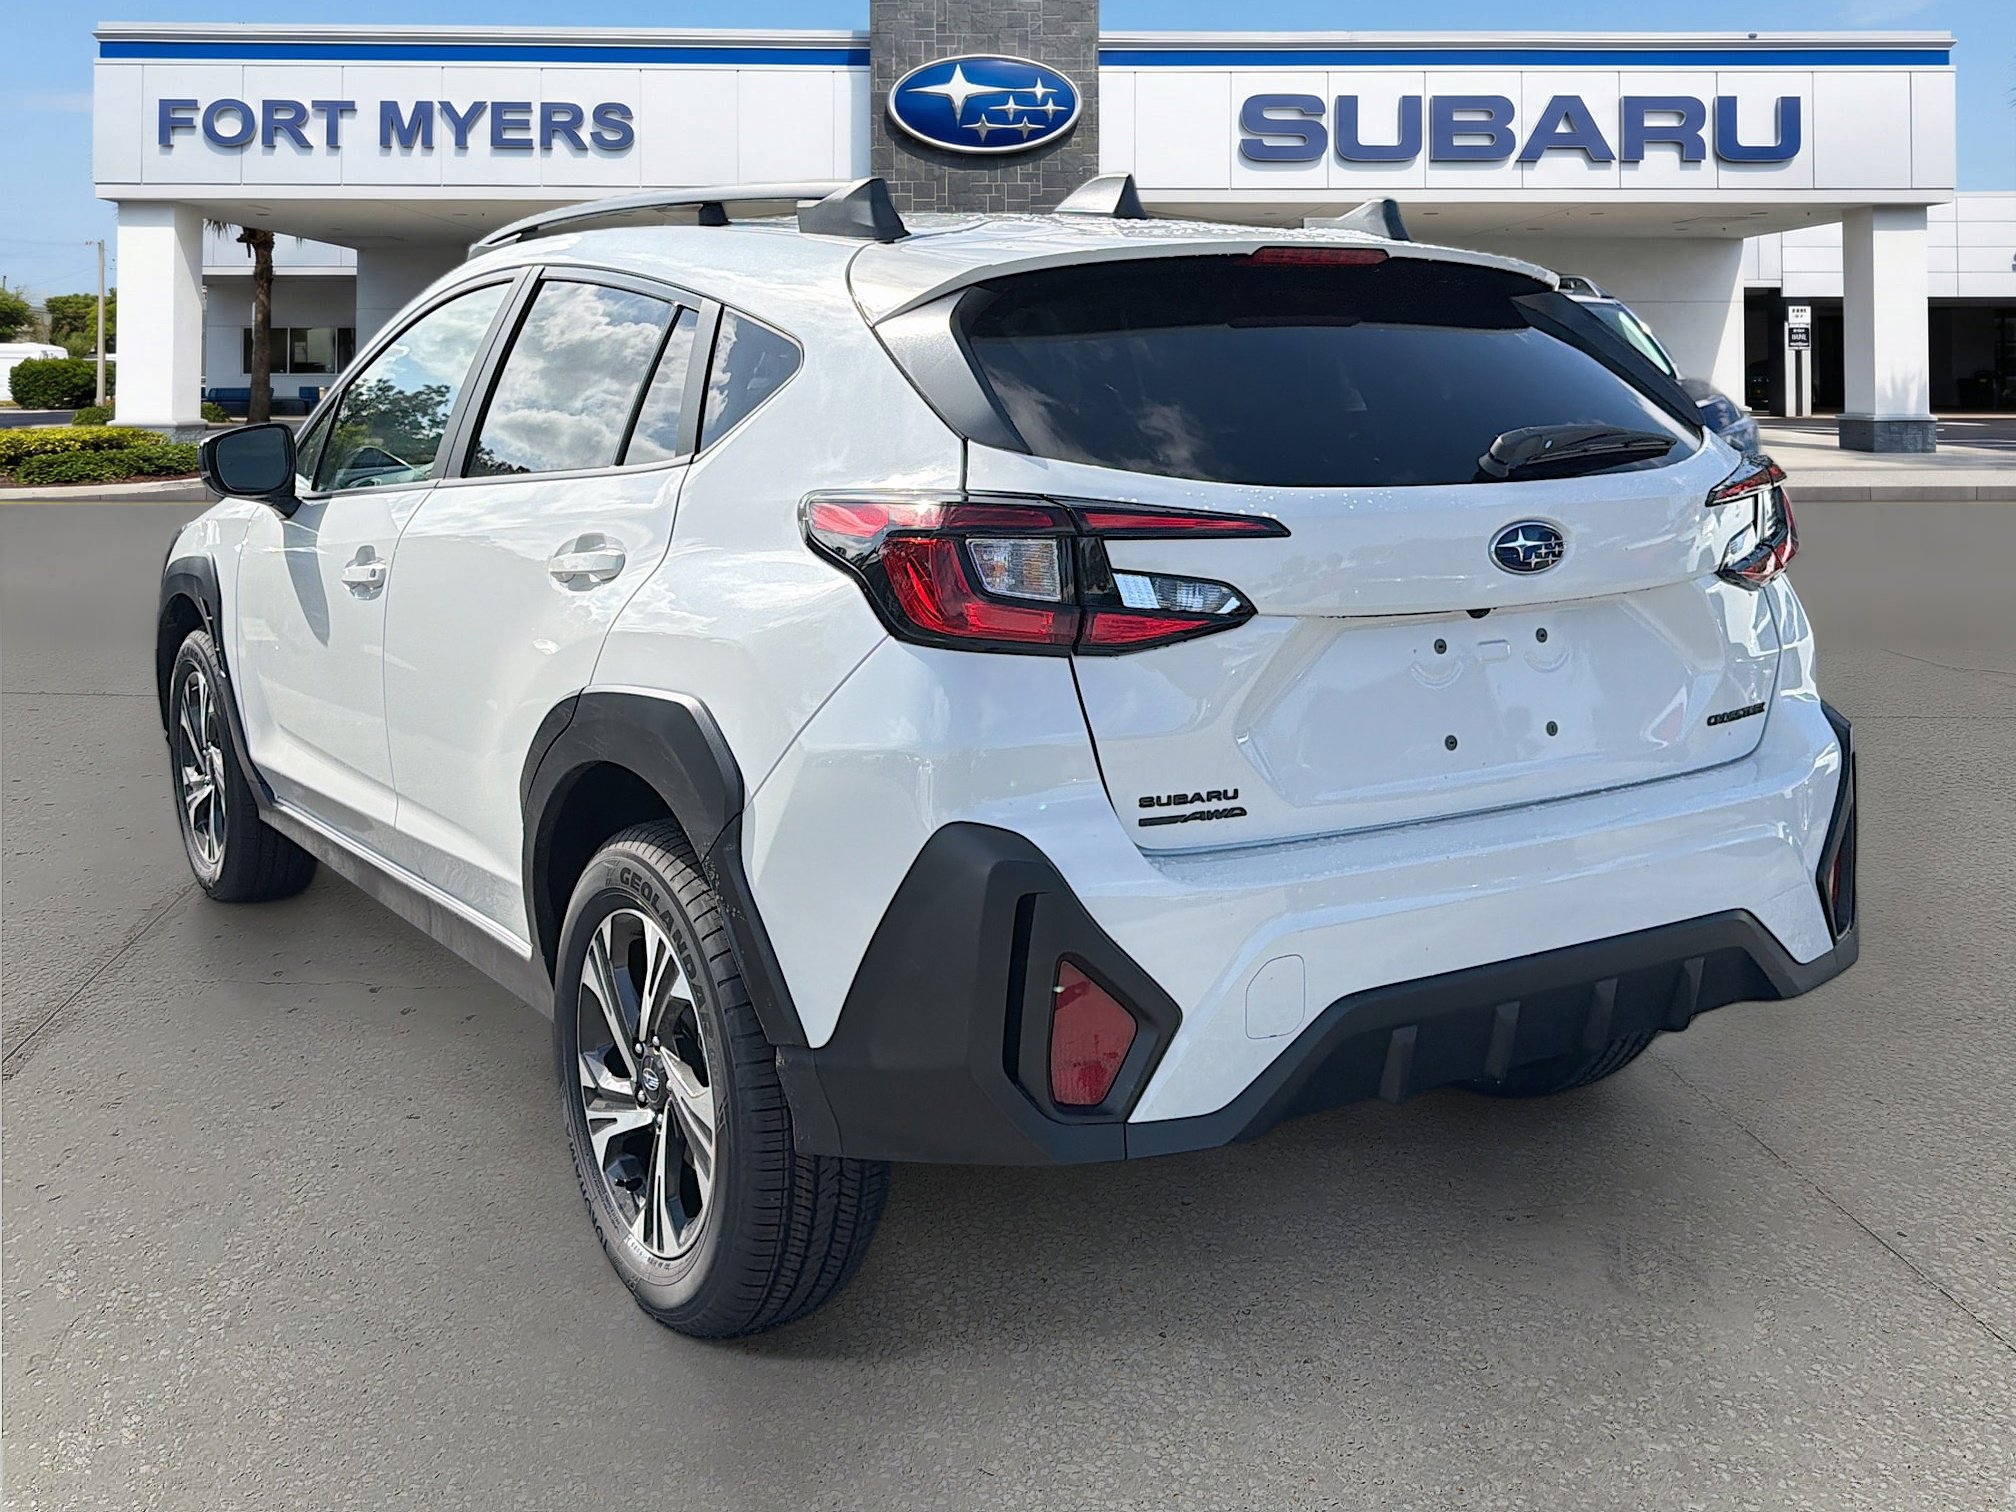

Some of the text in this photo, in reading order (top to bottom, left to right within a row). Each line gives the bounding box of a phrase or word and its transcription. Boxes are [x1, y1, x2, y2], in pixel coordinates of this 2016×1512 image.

[158, 98, 636, 151] FORT MYERS
[1239, 93, 1802, 164] SUBARU
[1138, 788, 1239, 808] SUBARU
[1180, 806, 1248, 823] AWD
